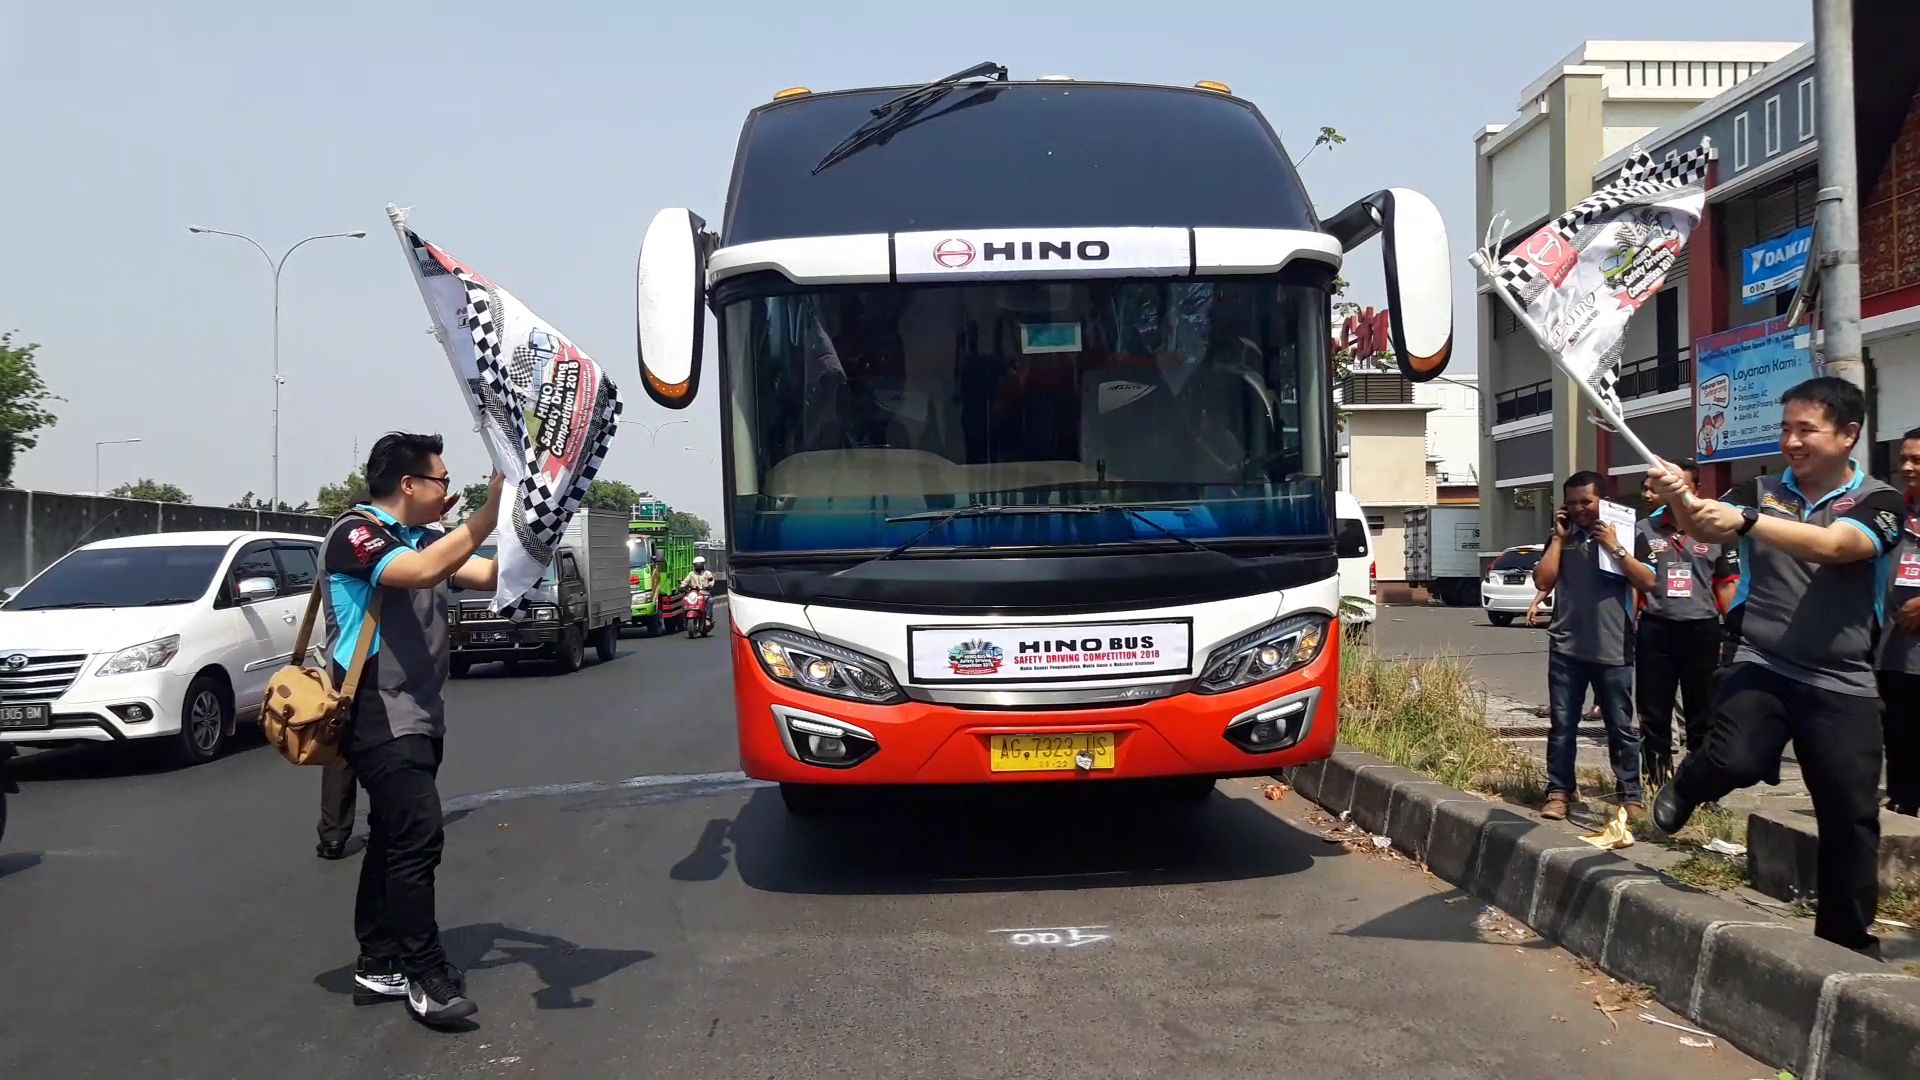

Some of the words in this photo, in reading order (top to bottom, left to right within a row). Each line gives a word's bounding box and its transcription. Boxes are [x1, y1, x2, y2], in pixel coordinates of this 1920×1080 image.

[983, 240, 1110, 261] HINO
[1554, 255, 1575, 281] HINO
[1624, 265, 1646, 286] Safety
[1644, 247, 1671, 269] Driving
[1628, 268, 1664, 298] Competition
[1732, 363, 1771, 380] Layanan
[1772, 355, 1797, 372] Kami
[551, 363, 569, 405] Driving
[537, 385, 554, 419] HINO
[551, 390, 575, 456] Competition
[566, 361, 579, 389] 2018
[541, 406, 562, 447] Safety
[462, 611, 501, 619] MITSU
[1014, 655, 1043, 665] SAFETY
[1046, 653, 1080, 663] DRIVING
[1083, 651, 1137, 662] COMPETITION
[1140, 650, 1160, 659] 2018
[1019, 639, 1102, 654] HINO
[1109, 636, 1154, 650] BUS
[1119, 688, 1163, 698] AVANTE
[1000, 738, 1022, 759] AG
[1032, 737, 1074, 758] 7323
